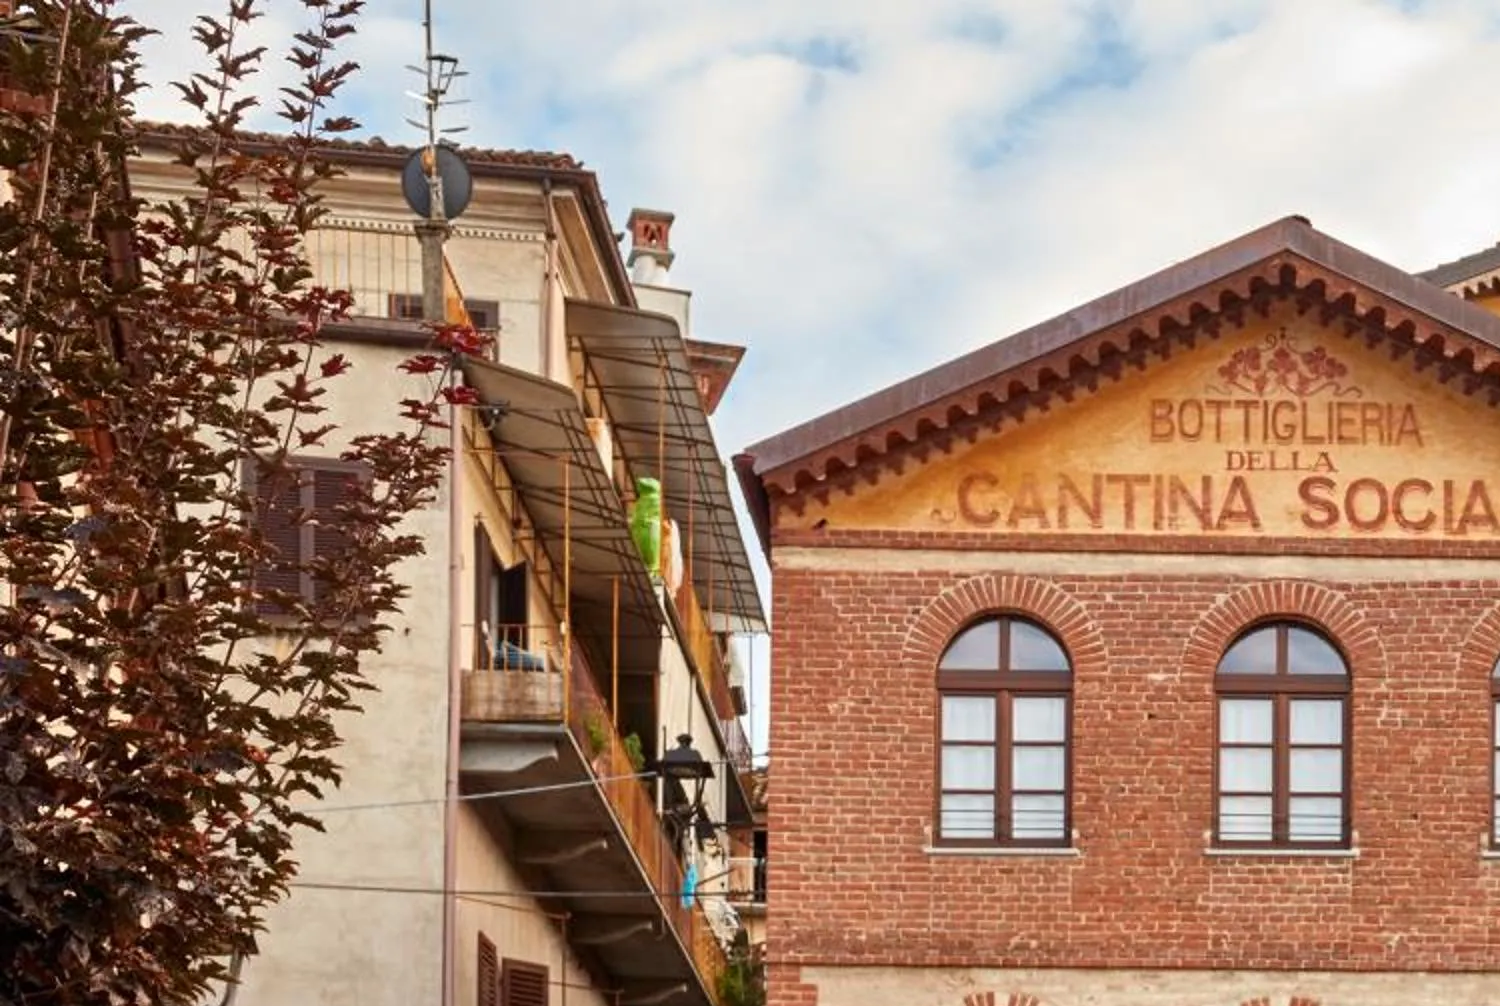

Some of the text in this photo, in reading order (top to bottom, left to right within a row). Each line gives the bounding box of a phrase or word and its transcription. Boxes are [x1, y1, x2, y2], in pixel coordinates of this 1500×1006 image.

[1149, 399, 1425, 448] BOTTIGLIERIA
[1225, 450, 1339, 473] DELLA
[957, 471, 1262, 532] CANTINA
